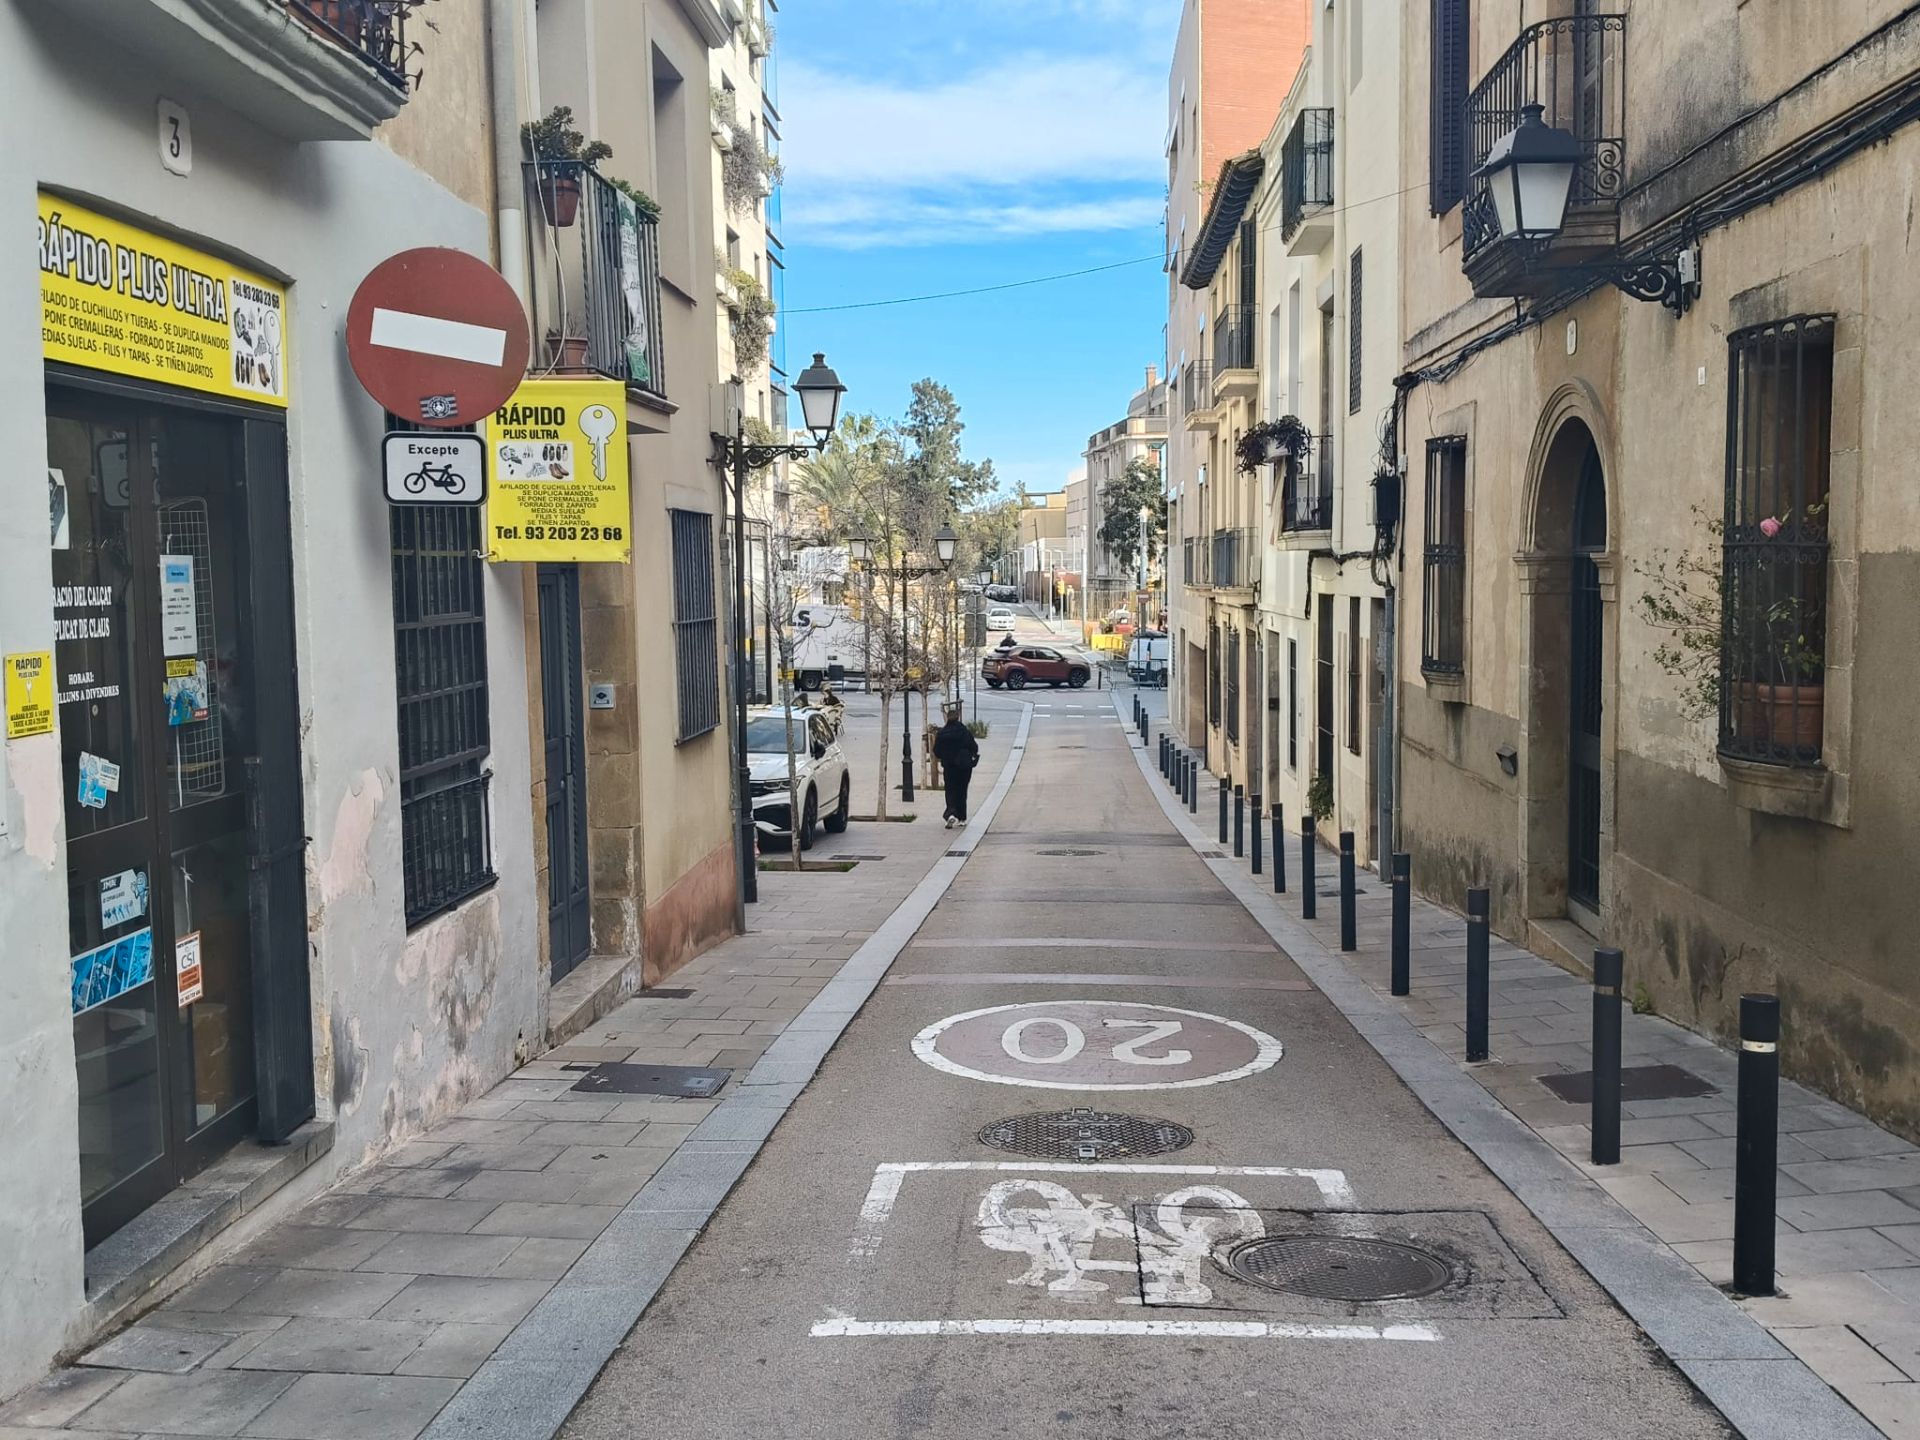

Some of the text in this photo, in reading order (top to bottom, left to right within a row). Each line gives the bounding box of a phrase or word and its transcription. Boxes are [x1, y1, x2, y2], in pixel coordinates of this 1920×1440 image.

[168, 116, 180, 158] 3
[39, 211, 228, 325] RÁPIDO PLUS ULTRA
[45, 309, 66, 327] PONE
[69, 315, 123, 340] CREMALLERAS
[129, 331, 164, 350] FORRADO
[166, 340, 175, 353] DE
[176, 342, 204, 360] ZAPATOS
[69, 297, 80, 312] DE
[82, 300, 123, 322] CUCHILLOS
[124, 312, 129, 324] Y
[163, 322, 172, 335] SE
[173, 325, 200, 342] DUPLICA
[201, 333, 230, 351] MANDOS
[68, 334, 97, 352] SUELAS
[122, 347, 127, 358] Y
[128, 348, 150, 364] TAPAS
[156, 354, 164, 368] SE
[165, 355, 186, 371] TIÑEN
[187, 362, 213, 379] ZAPATOS
[496, 402, 565, 426] RÁPIDO
[503, 429, 559, 440] PLUS ULTRA
[408, 443, 459, 456] Excepte
[496, 526, 623, 541] Tel. 93 203 23 68
[73, 586, 87, 606] DEL
[88, 586, 112, 612] CALÇAT
[79, 618, 89, 639] DE
[89, 617, 110, 638] CLAUS
[85, 685, 119, 700] DIVENDRES
[1001, 1016, 1193, 1066] 20
